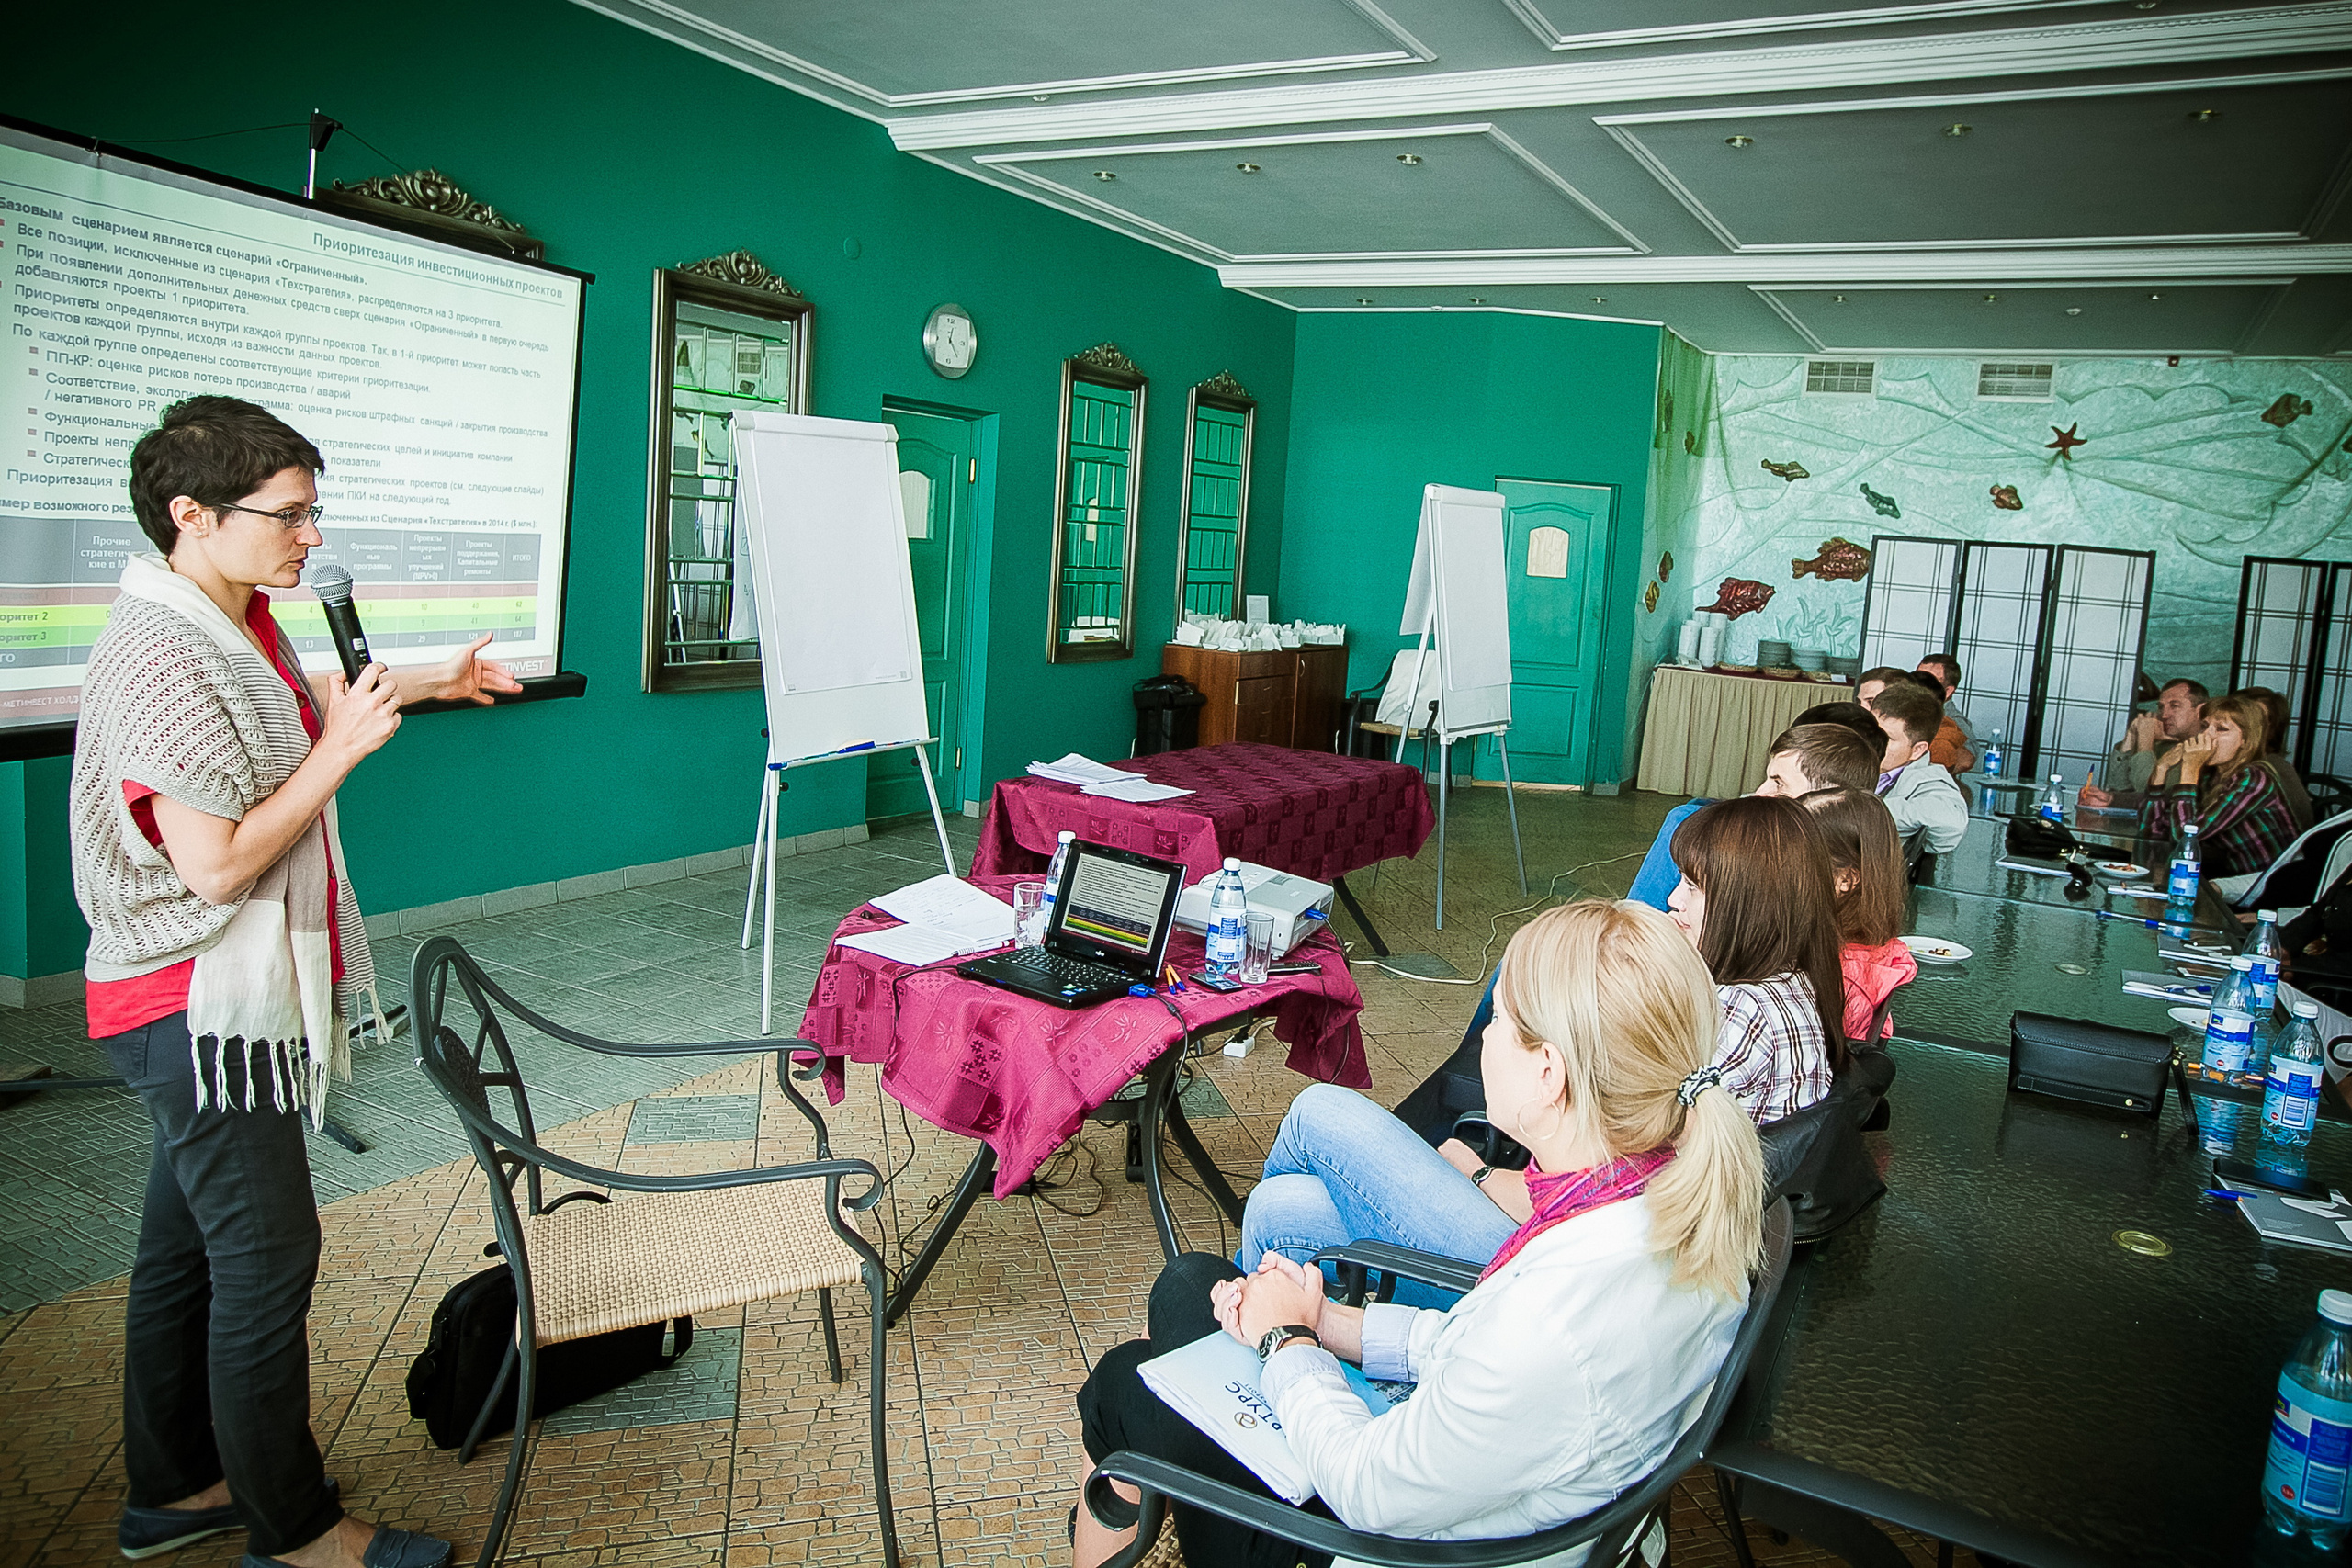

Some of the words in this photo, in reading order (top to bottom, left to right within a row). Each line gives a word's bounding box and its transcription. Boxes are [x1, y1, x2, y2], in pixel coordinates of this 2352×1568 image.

[72, 215, 149, 241] сценарием
[153, 232, 212, 254] является
[216, 244, 272, 265] сценарий
[276, 258, 368, 286] «Ограниченный».
[313, 232, 414, 267] Приоритезация
[417, 258, 514, 288] инвестиционных
[515, 281, 563, 299] проектов
[15, 265, 108, 289] добавляются
[113, 281, 166, 300] проекты
[172, 293, 177, 302] 1
[182, 294, 249, 315] приоритета.
[17, 223, 43, 238] Все
[48, 231, 107, 253] позиции,
[114, 245, 198, 271] исключенные
[203, 263, 215, 274] из
[220, 267, 270, 285] сценария
[275, 277, 355, 301] «Техстратегия»,
[358, 293, 433, 316] распределяются
[435, 309, 446, 318] на
[448, 310, 453, 319] 3
[456, 313, 503, 328] приоритета.
[17, 244, 43, 260] При
[50, 254, 123, 276] появлении
[128, 268, 229, 295] дополнительных
[233, 289, 287, 306] денежных
[291, 299, 331, 314] средств
[334, 307, 360, 320] сверх
[364, 311, 405, 327] сценария
[410, 320, 479, 340] «Ограниченный»
[490, 333, 517, 347] первую
[519, 340, 549, 353] очередь
[14, 284, 99, 309] Приоритеты
[106, 301, 198, 325] определяются
[201, 319, 239, 333] внутри
[243, 325, 281, 340] каждой
[285, 332, 320, 345] группы
[323, 338, 368, 353] проектов.
[371, 344, 389, 355] Так,
[392, 348, 398, 356] в
[401, 349, 413, 359] 1-й
[416, 353, 459, 367] приоритет
[462, 360, 486, 371] может
[490, 364, 519, 375] попасть
[521, 369, 541, 378] часть
[14, 304, 81, 324] проектов
[85, 315, 131, 332] каждой
[137, 324, 183, 342] группы,
[187, 332, 227, 346] исходя
[231, 340, 243, 348] из
[246, 343, 294, 356] важности
[299, 351, 335, 362] данных
[339, 355, 382, 368] проектов.
[13, 323, 32, 337] По
[39, 331, 90, 347] каждой
[94, 338, 137, 353] группе
[141, 345, 216, 365] определены
[220, 356, 312, 378] соответствующие
[317, 370, 359, 383] критерии
[363, 377, 431, 393] приоритезации.
[46, 350, 93, 367] ПП-КР:
[97, 358, 143, 373] оценка
[149, 366, 189, 380] рисков
[194, 371, 232, 387] потерь
[236, 378, 307, 394] производства
[311, 386, 315, 395] /
[317, 389, 351, 400] аварий
[45, 389, 51, 400] /
[55, 392, 132, 409] негативного
[138, 400, 156, 412] PR
[46, 372, 140, 394] Соответствие,
[299, 403, 332, 415] оценка
[336, 408, 367, 419] рисков
[368, 412, 415, 423] штрафных
[420, 417, 453, 429] санкций
[460, 423, 496, 433] закрытия
[499, 426, 548, 438] производства
[45, 431, 98, 446] Проекты
[331, 457, 381, 468] показатели
[322, 438, 390, 453] стратегических
[395, 446, 422, 456] целей
[432, 450, 473, 460] инициатив
[477, 453, 513, 462] компании
[7, 469, 112, 488] Приоритезация
[347, 491, 367, 500] ПКИ
[382, 493, 433, 505] следующий
[436, 496, 451, 506] год.
[339, 475, 405, 486] стратегических
[411, 480, 447, 489] проектов
[450, 481, 466, 491] (см.
[468, 483, 512, 493] следующие
[514, 487, 544, 496] слайды)
[34, 502, 109, 513] возможного
[381, 514, 423, 525] Сценария
[424, 516, 481, 527] «Техстратегия»
[489, 519, 503, 527] 2014
[93, 536, 131, 547] Прочие
[466, 540, 492, 548] Проекты
[41, 632, 47, 640] 3
[42, 612, 48, 620] 2
